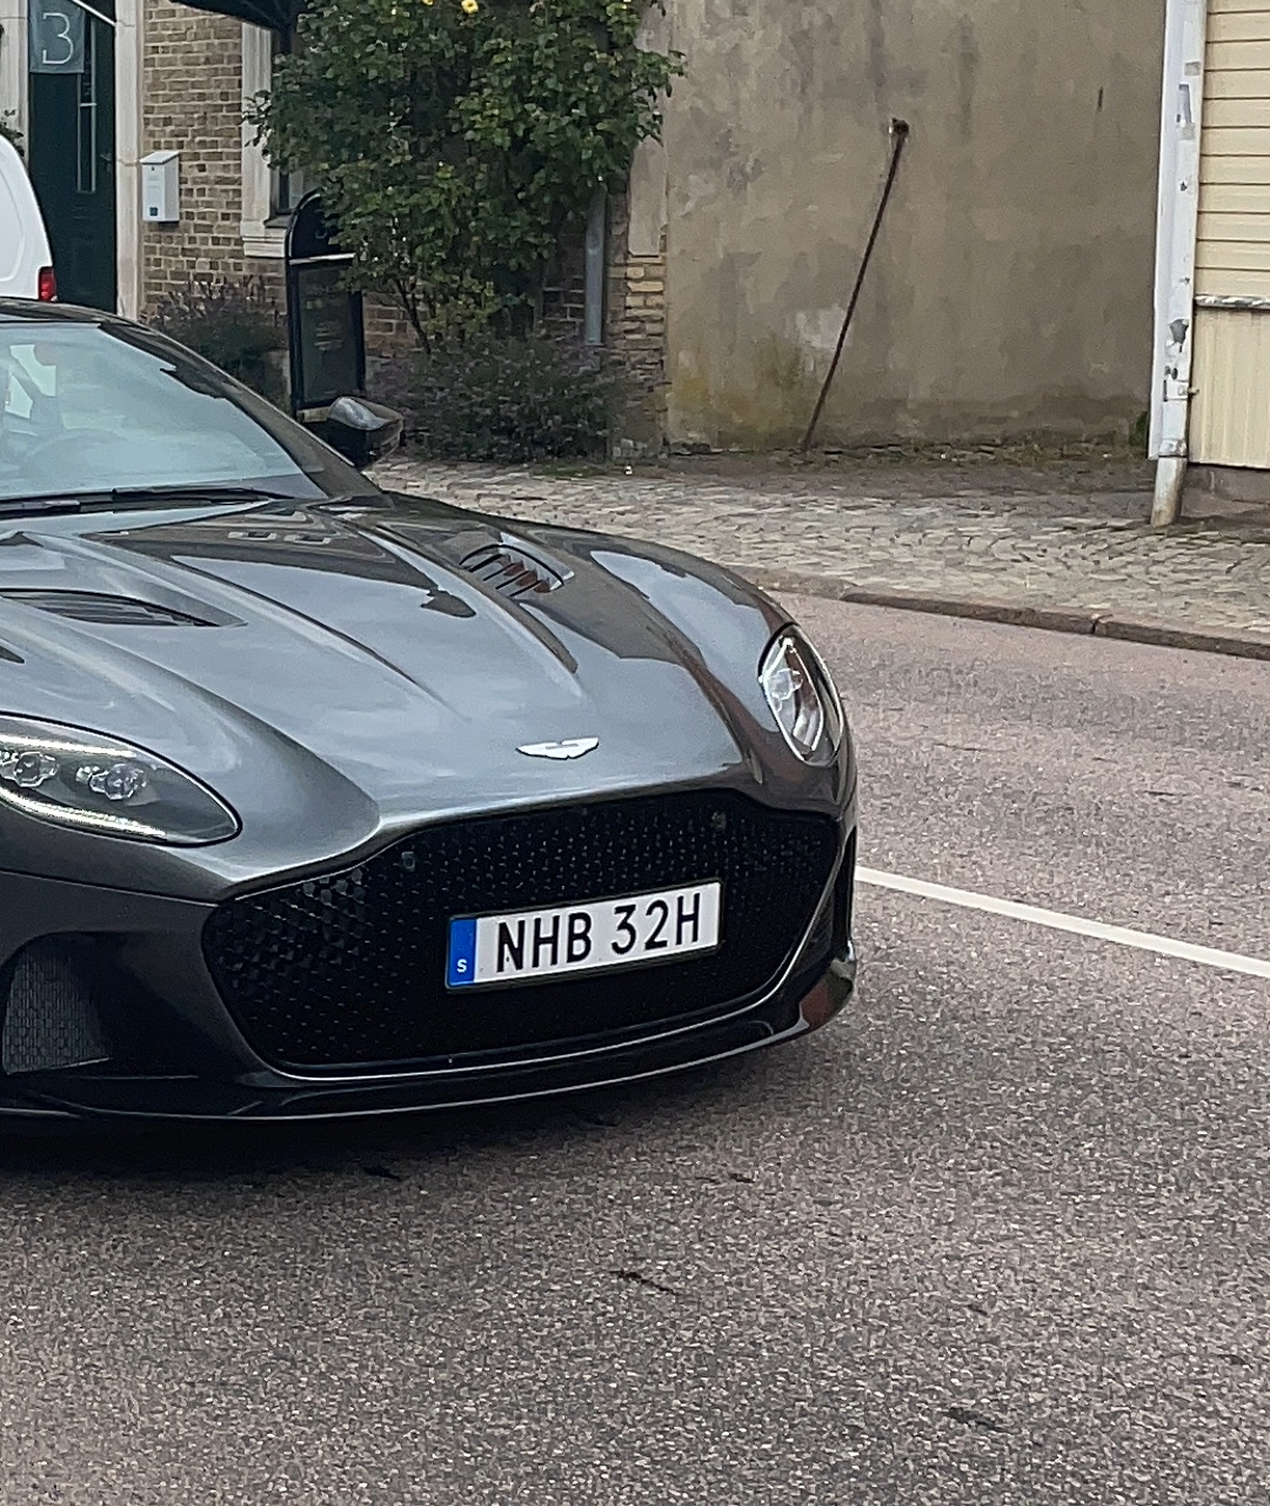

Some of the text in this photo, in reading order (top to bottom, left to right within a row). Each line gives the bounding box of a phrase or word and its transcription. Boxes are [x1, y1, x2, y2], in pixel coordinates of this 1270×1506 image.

[42, 11, 75, 65] 3
[495, 892, 701, 973] NHB 32H
[456, 958, 468, 973] S
